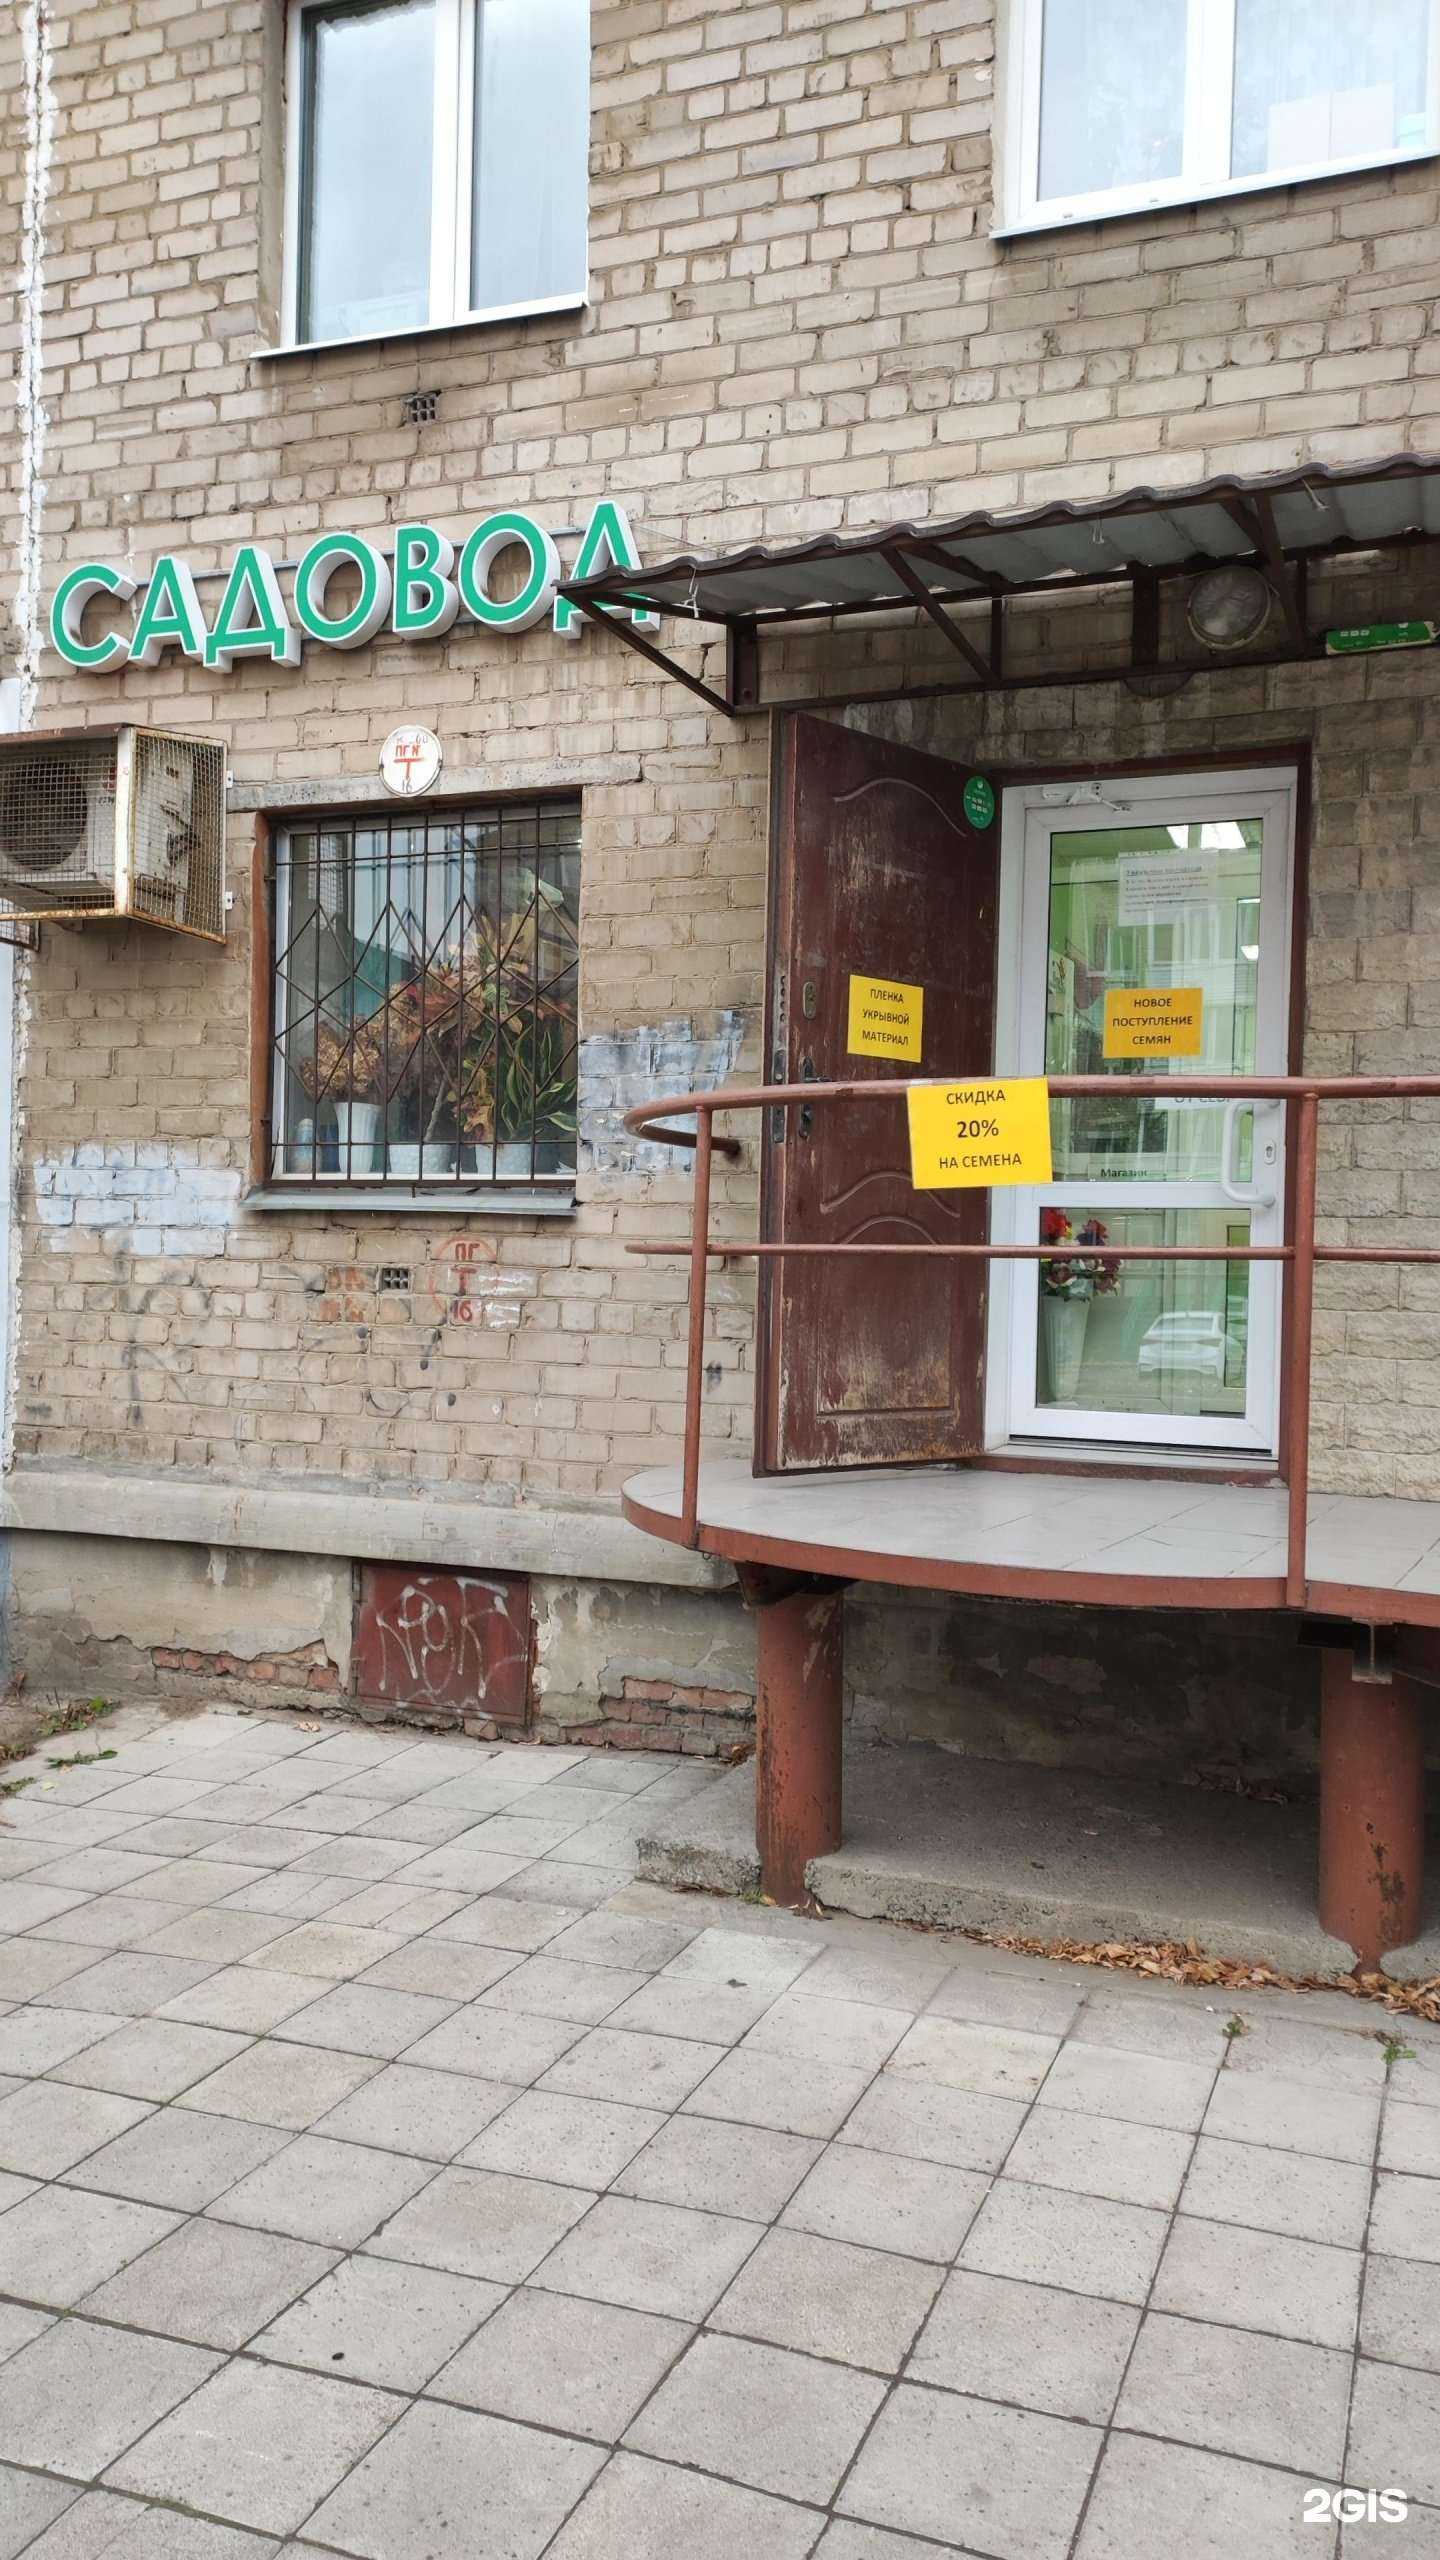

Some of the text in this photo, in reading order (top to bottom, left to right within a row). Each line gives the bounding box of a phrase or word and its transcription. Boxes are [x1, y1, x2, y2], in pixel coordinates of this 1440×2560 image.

[50, 500, 659, 673] САДОВОД
[869, 988, 904, 1003] ПЛЕНКА
[1134, 997, 1172, 1008] НОВОЕ
[862, 1008, 910, 1025] УКРЫВНОЙ
[1112, 1015, 1193, 1027] ПОСТУПЛЕНИЕ
[862, 1030, 909, 1046] МАТЕРИАЛ
[1132, 1035, 1171, 1045] СЕМЯН
[946, 1089, 1006, 1105] СКИДКА
[956, 1119, 999, 1138] 20%
[939, 1152, 1022, 1169] НА СЕМЕНА
